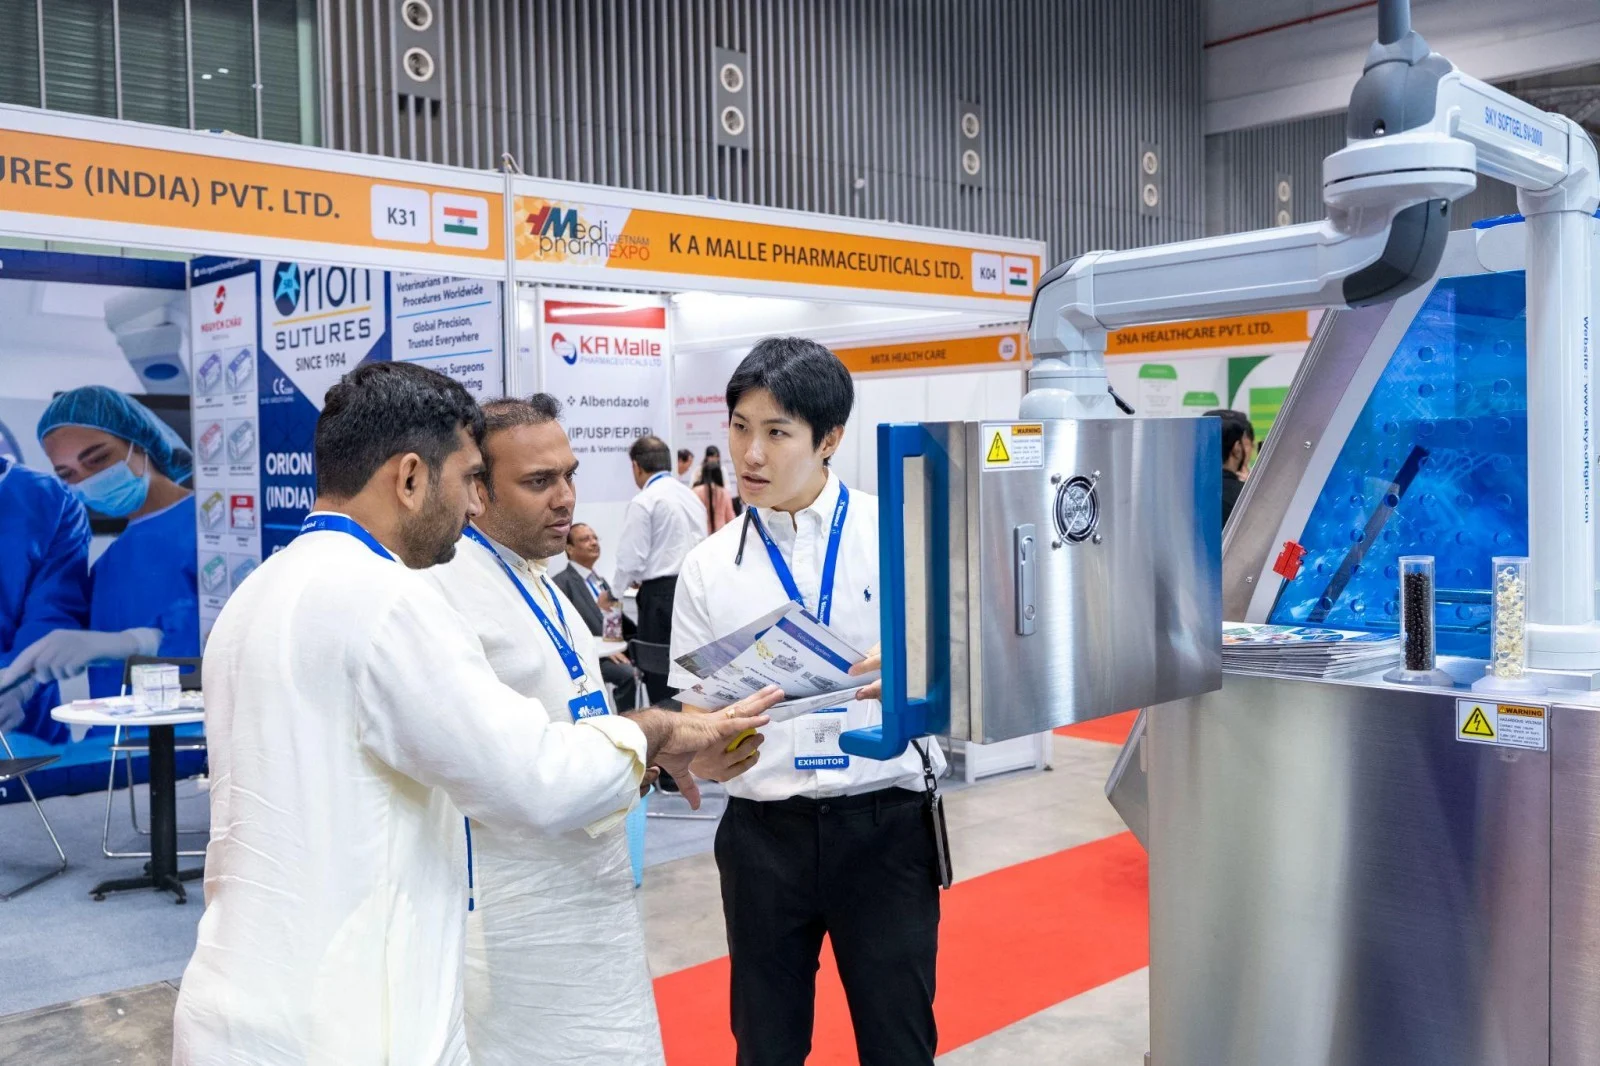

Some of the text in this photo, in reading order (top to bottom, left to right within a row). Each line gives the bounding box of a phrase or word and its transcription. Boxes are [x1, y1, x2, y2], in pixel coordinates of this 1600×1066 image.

[1485, 106, 1497, 126] SKY
[85, 165, 200, 207] (INDIA)
[210, 181, 274, 212] PVT.
[283, 189, 340, 219] LTD.
[387, 207, 417, 227] K31
[540, 235, 608, 257] pharm
[609, 234, 649, 246] VIETNAM
[609, 244, 650, 261] EXPO
[669, 232, 964, 280] K A MALLE PHARMACEUTICALS LTD.
[980, 267, 996, 280] K04
[396, 277, 441, 292] Veterinarians
[403, 283, 484, 307] Procedures Worldwide
[413, 316, 472, 333] Global Precision,
[1116, 321, 1273, 345] SNA HEALTHCARE PVT. LTD.
[275, 318, 371, 351] SUTURES
[408, 332, 479, 349] Trusted Everywhere
[580, 335, 661, 356] KA Malle
[924, 348, 947, 361] CARE
[296, 352, 346, 371] SINCE 1994
[450, 362, 484, 376] Surgeons
[580, 396, 649, 407] Albendazole
[265, 452, 313, 475] ORION
[266, 486, 314, 512] (INDIA)
[1505, 707, 1542, 717] WARNING
[798, 757, 845, 767] EXHIBITOR
